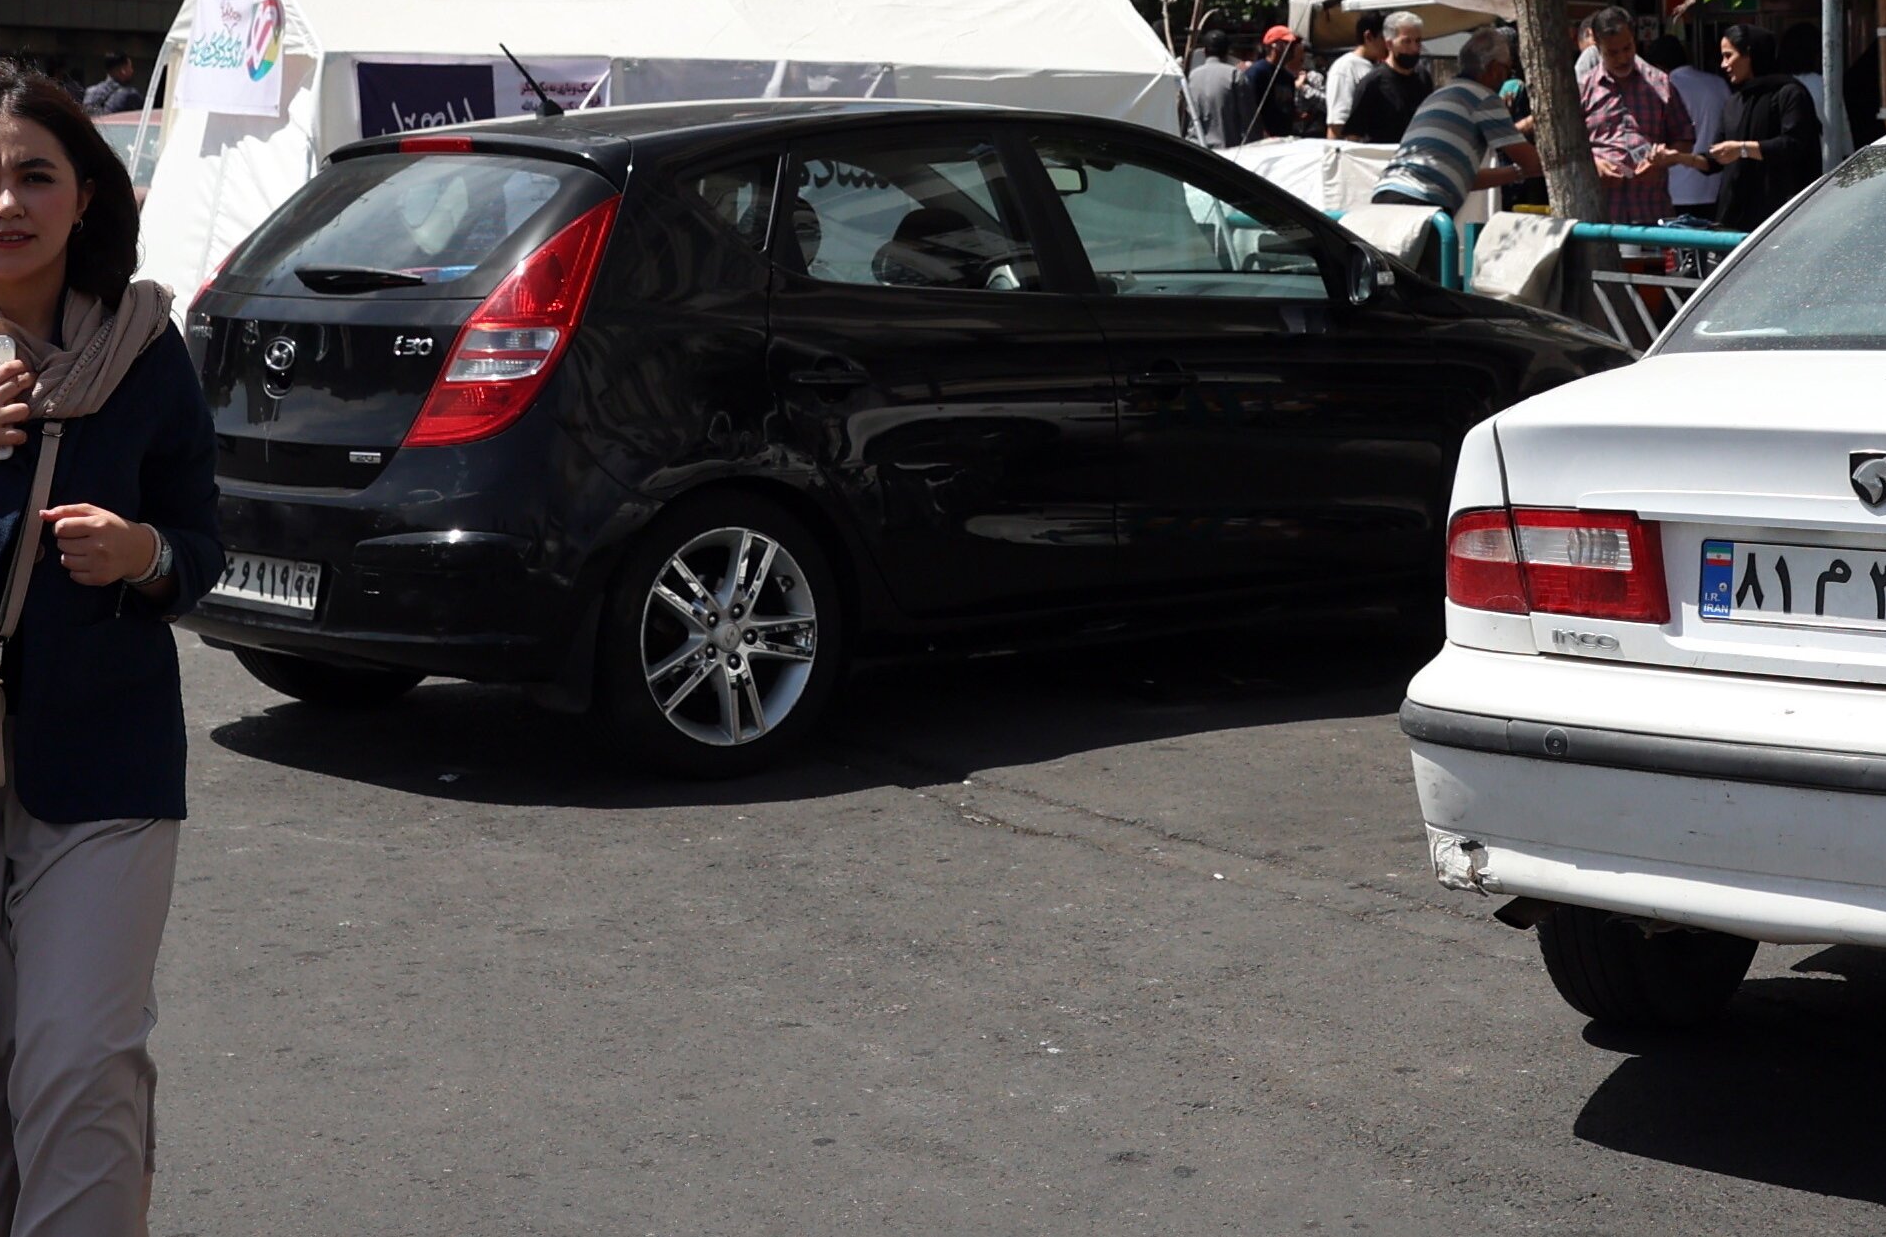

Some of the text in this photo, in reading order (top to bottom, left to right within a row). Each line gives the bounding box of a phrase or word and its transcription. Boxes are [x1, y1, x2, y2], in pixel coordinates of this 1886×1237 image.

[393, 334, 434, 356] i30
[256, 562, 290, 601] ۹۱۹
[295, 574, 315, 607] ۹۹
[1735, 552, 1792, 614] ۸۱
[1815, 558, 1852, 616] م
[1703, 604, 1729, 615] IRAN
